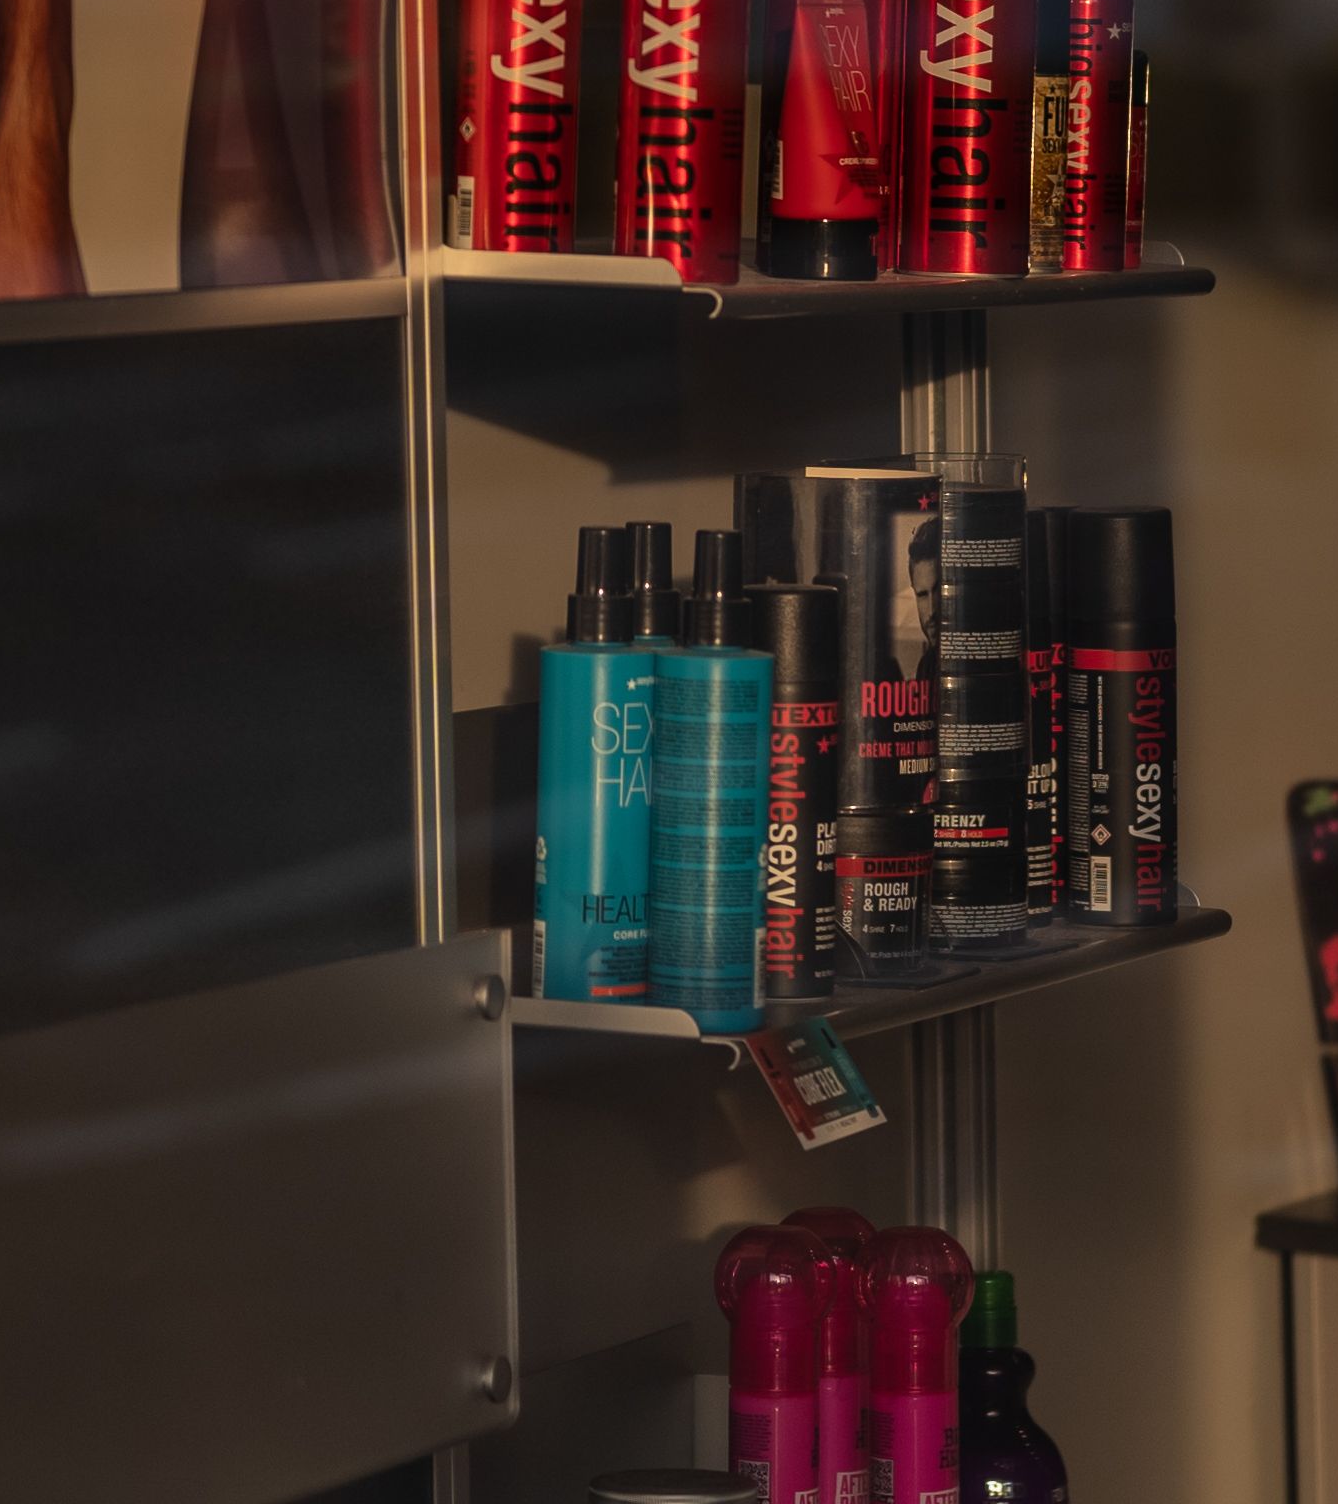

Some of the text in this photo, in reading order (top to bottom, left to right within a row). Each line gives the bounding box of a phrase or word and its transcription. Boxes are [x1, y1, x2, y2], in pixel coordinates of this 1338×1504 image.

[861, 679, 931, 719] ROUGH
[1127, 676, 1167, 913] stylesexyhair
[933, 814, 986, 828] FRENZY
[864, 882, 909, 897] ROUGH
[863, 896, 918, 912] & READY
